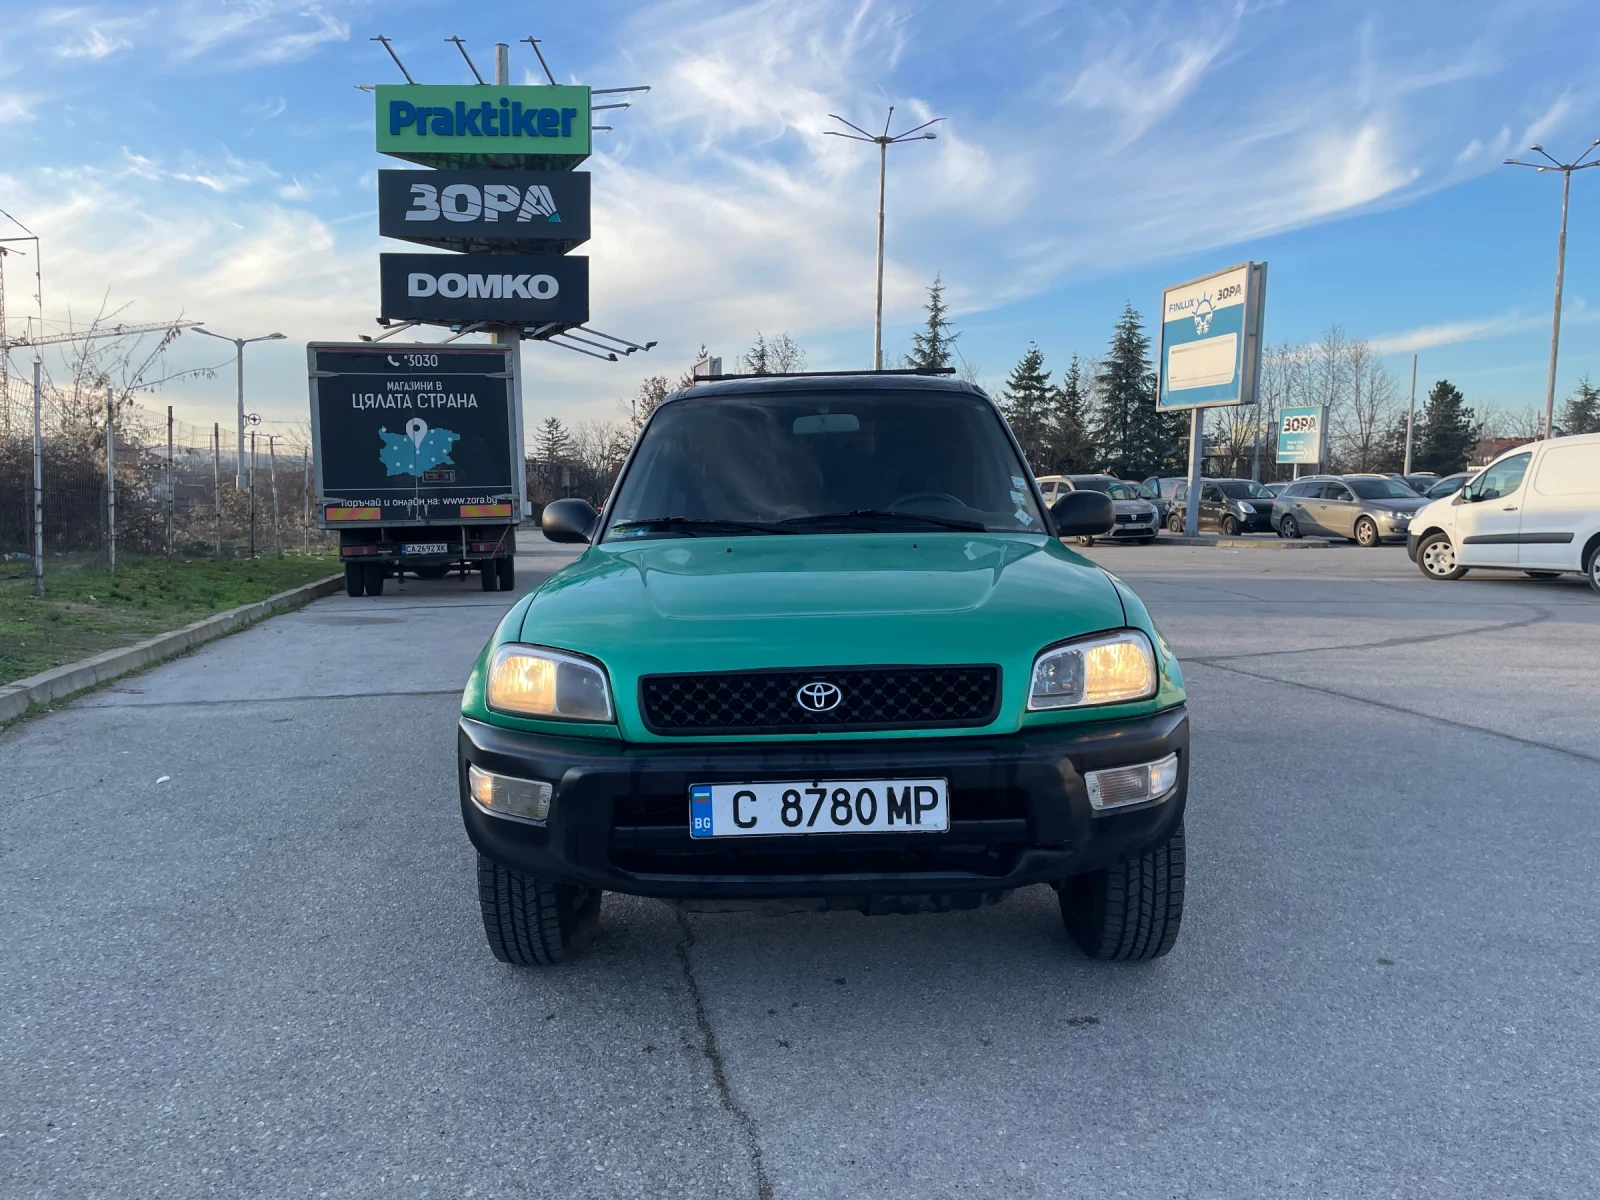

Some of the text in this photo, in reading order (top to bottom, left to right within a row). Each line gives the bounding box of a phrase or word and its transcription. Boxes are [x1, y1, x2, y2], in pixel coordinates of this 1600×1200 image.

[389, 97, 578, 138] Praktiker
[404, 184, 562, 223] ЗОРА
[407, 273, 560, 300] DOMKO
[1169, 298, 1195, 313] FINLUX
[386, 381, 443, 391] МАГАЗИНИ В
[352, 393, 479, 410] ЦЯЛАТА СТРАНА
[1283, 415, 1319, 433] ЗОРА
[732, 785, 939, 829] C 8780 MP
[694, 817, 711, 830] BG
